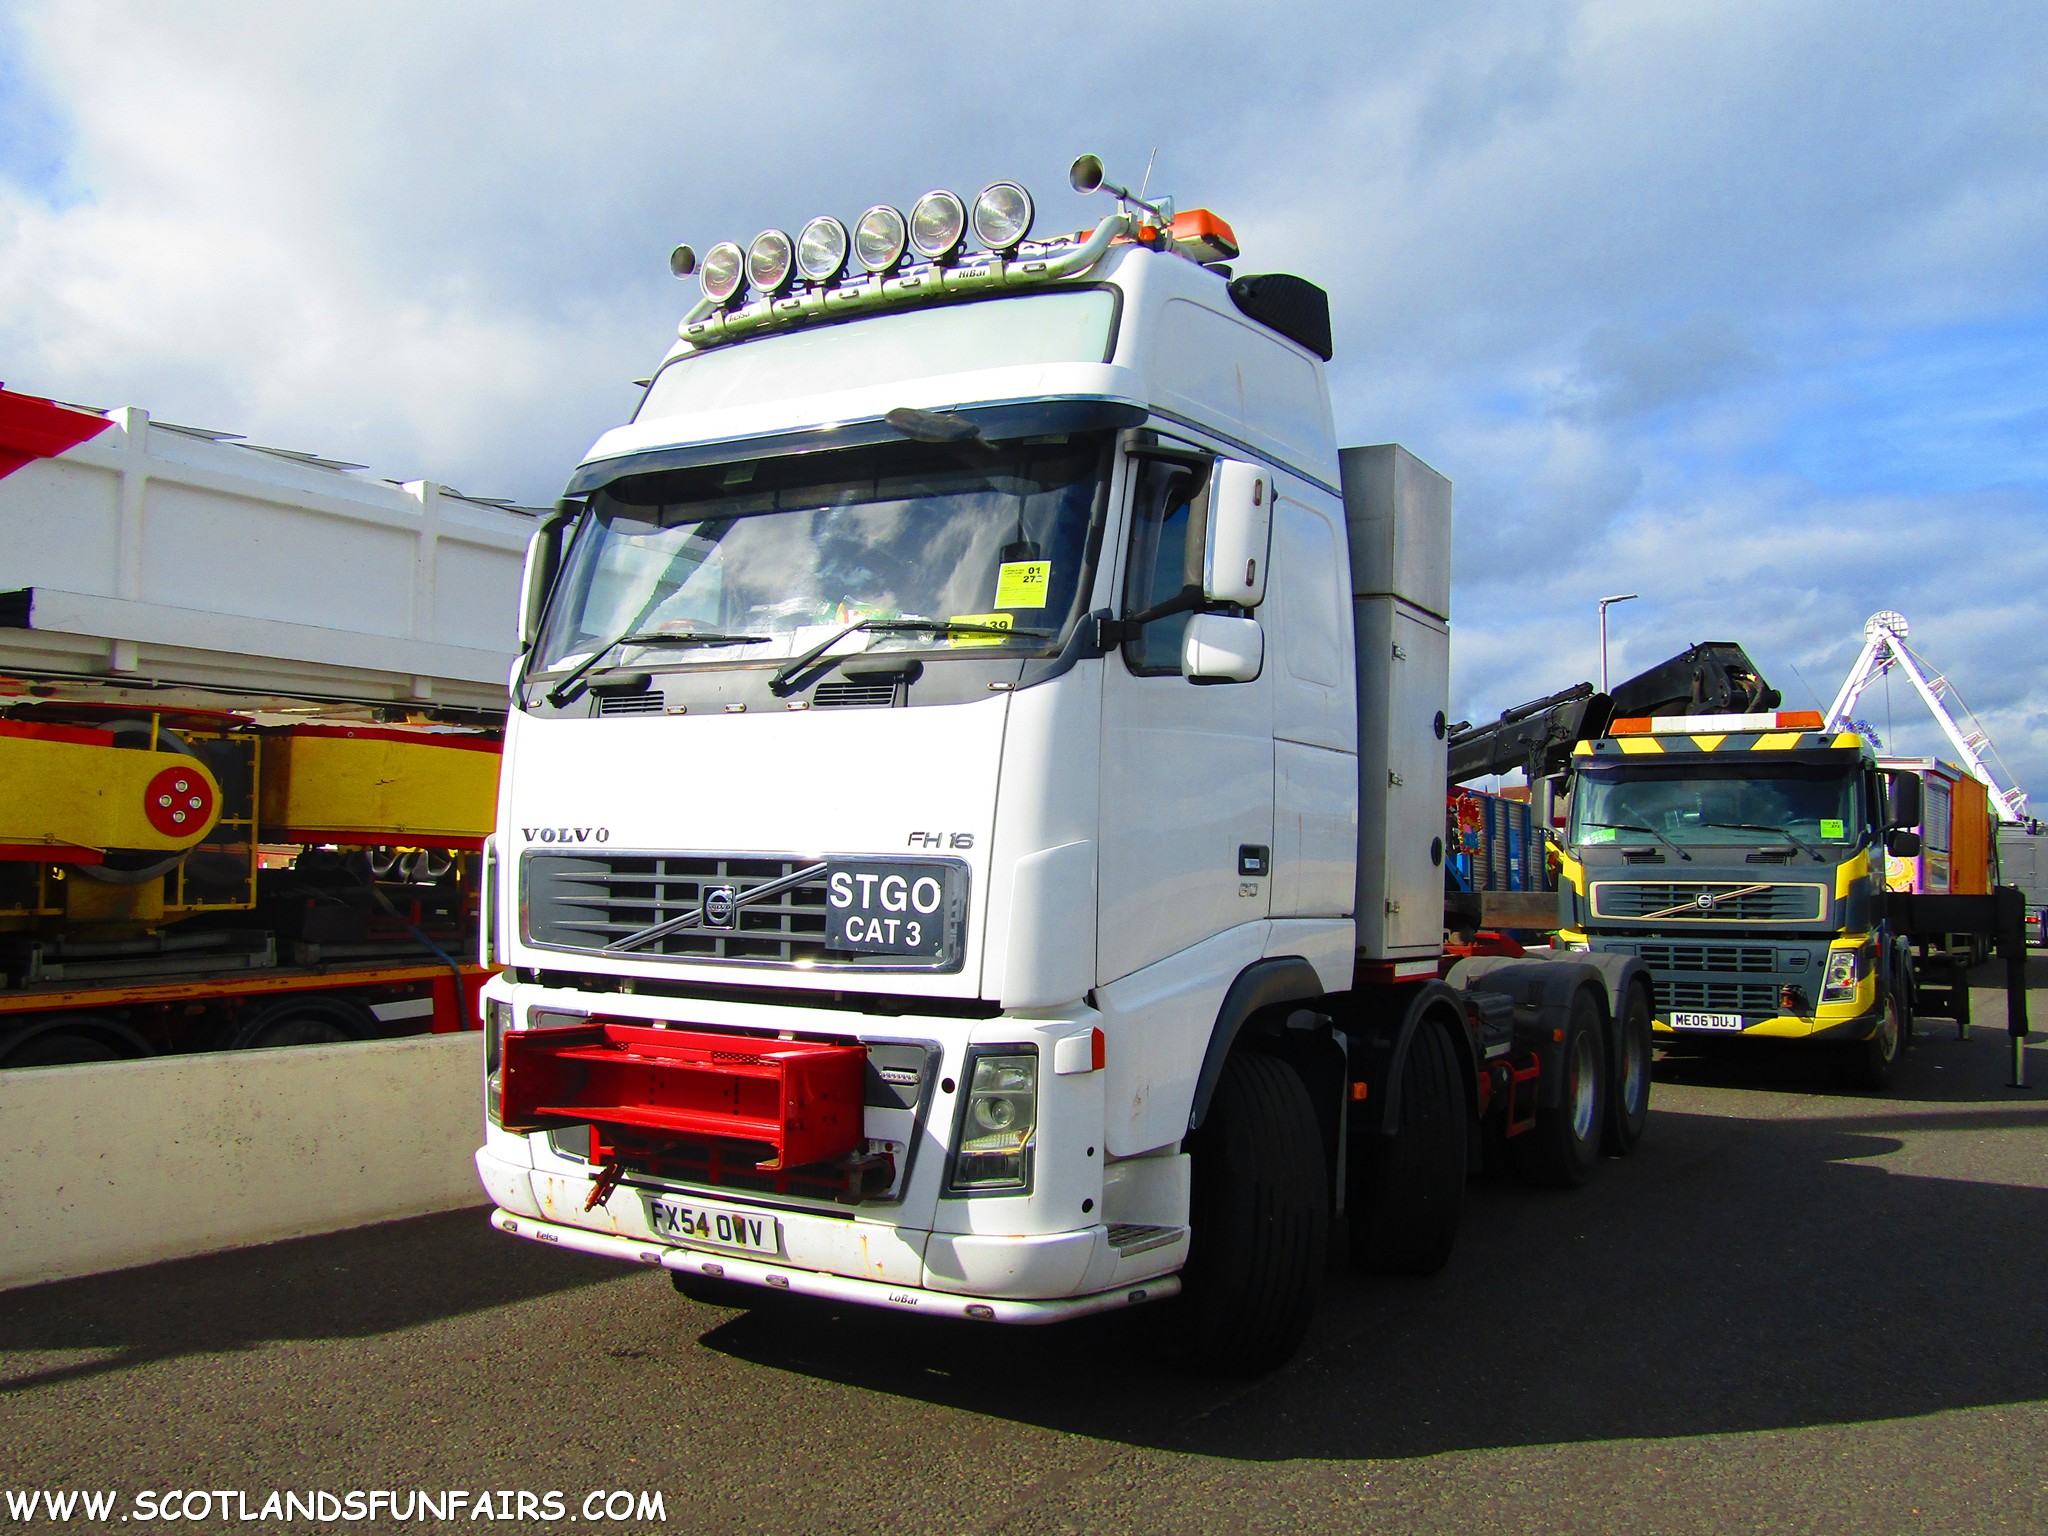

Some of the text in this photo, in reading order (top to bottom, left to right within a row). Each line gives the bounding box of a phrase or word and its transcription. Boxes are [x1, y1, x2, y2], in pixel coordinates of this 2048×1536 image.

[1028, 566, 1041, 575] 01
[1023, 575, 1043, 583] 27
[521, 827, 610, 843] VOLVO
[829, 871, 941, 914] STGO
[845, 915, 921, 947] CAT 3
[1675, 1014, 1737, 1028] ME06 DUJ
[650, 1201, 710, 1238] FX54
[888, 1291, 919, 1306] LoBar
